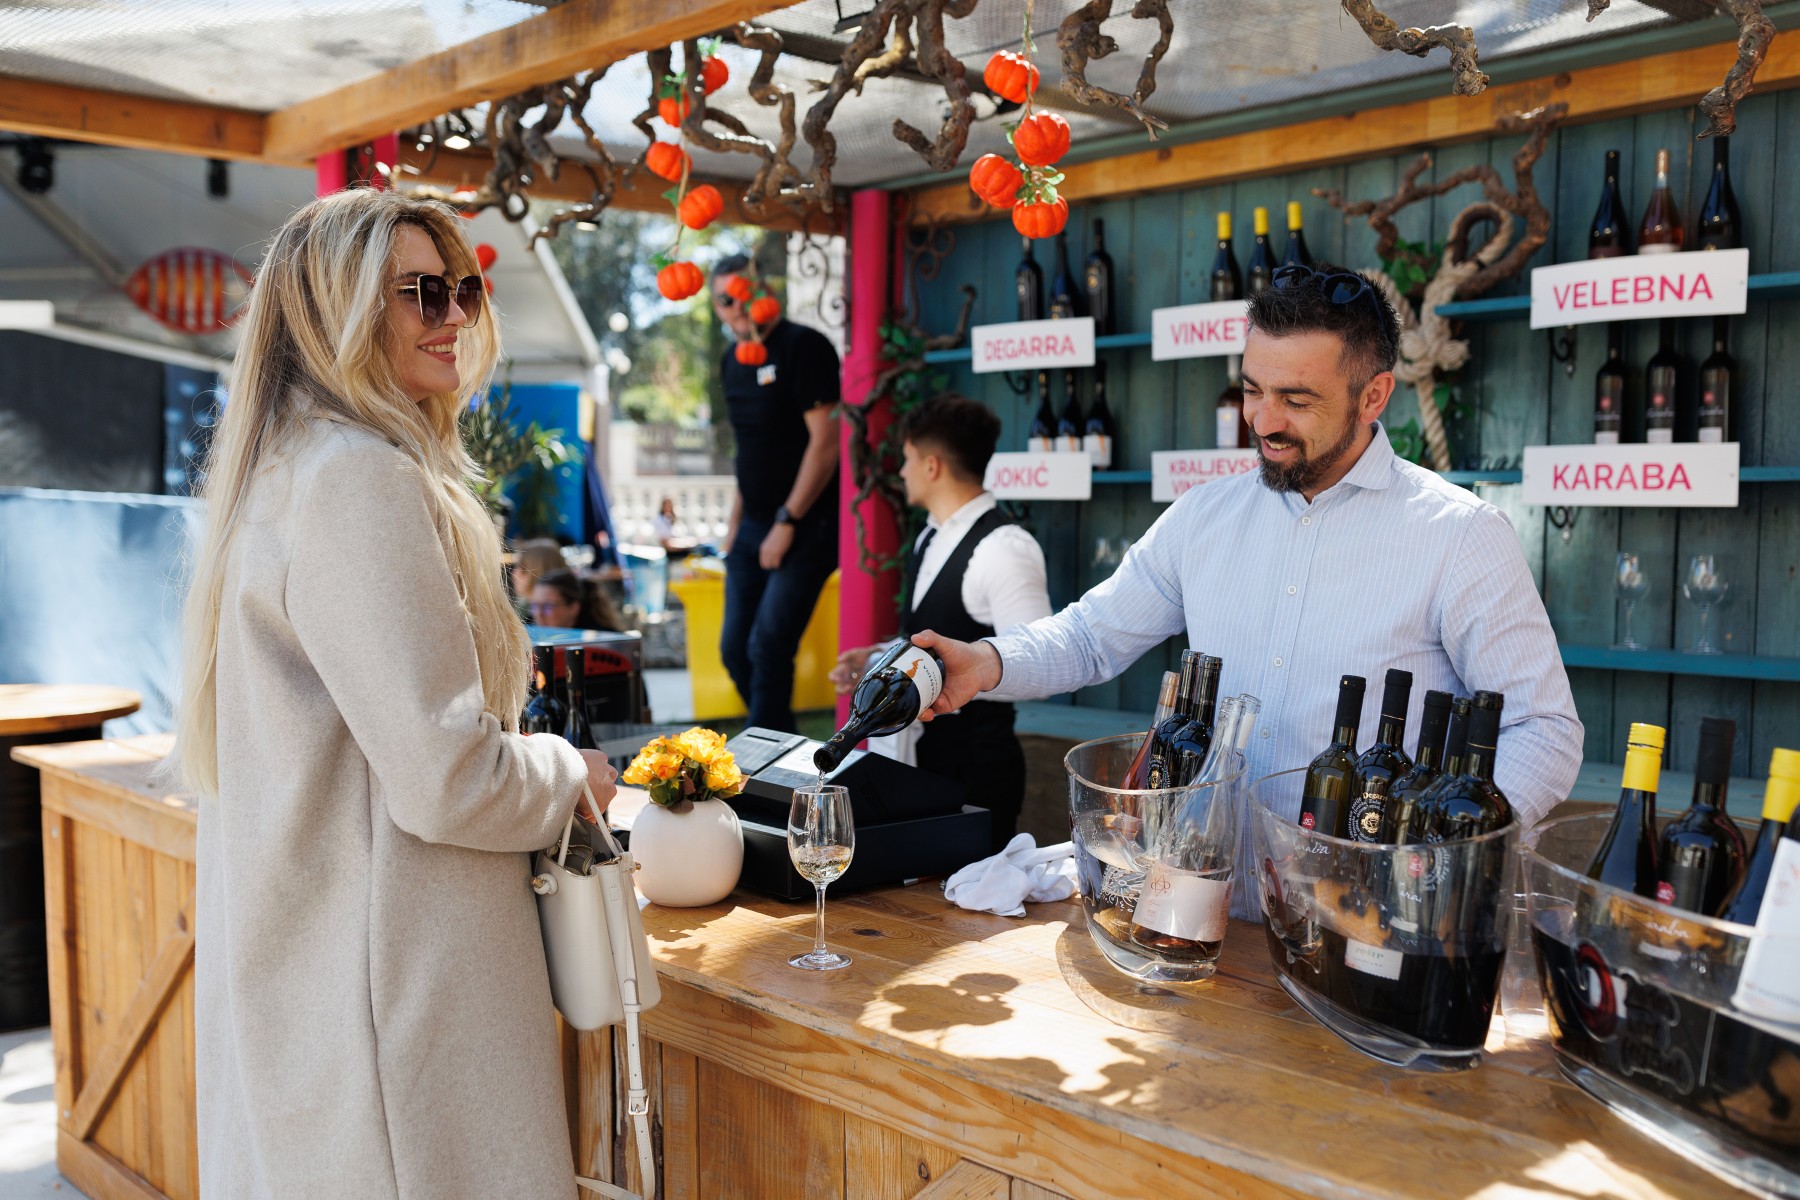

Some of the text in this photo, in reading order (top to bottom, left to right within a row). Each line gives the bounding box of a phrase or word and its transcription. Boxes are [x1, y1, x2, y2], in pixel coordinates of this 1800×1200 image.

[1553, 272, 1714, 311] VELEBNA
[985, 335, 1076, 361] DEGARRA
[992, 461, 1049, 489] JOKIĆ
[1552, 462, 1693, 492] KARABA
[1362, 792, 1388, 801] Degarr
